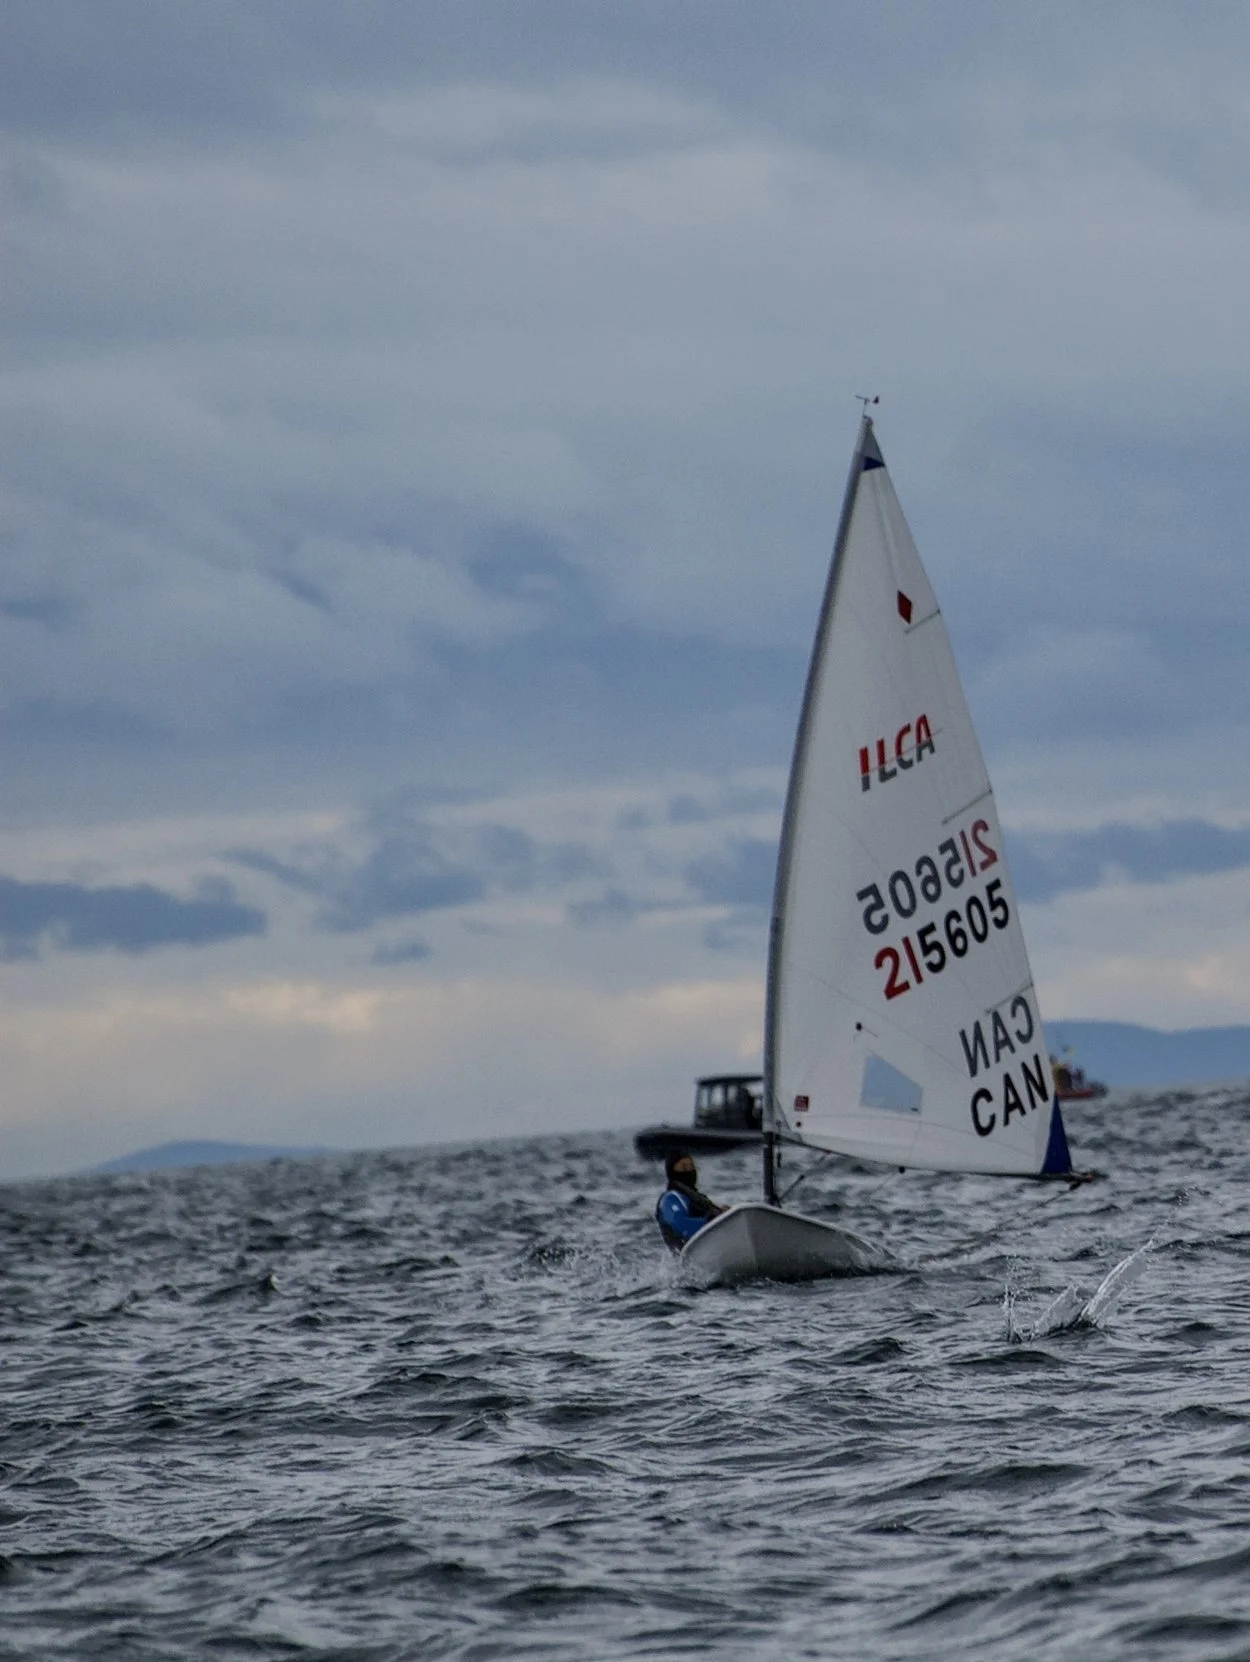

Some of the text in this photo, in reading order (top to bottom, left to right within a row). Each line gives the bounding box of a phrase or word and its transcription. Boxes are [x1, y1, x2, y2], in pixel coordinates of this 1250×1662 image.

[859, 714, 935, 791] ILCA
[874, 879, 1010, 1000] 215605
[970, 1053, 1049, 1137] CAN
